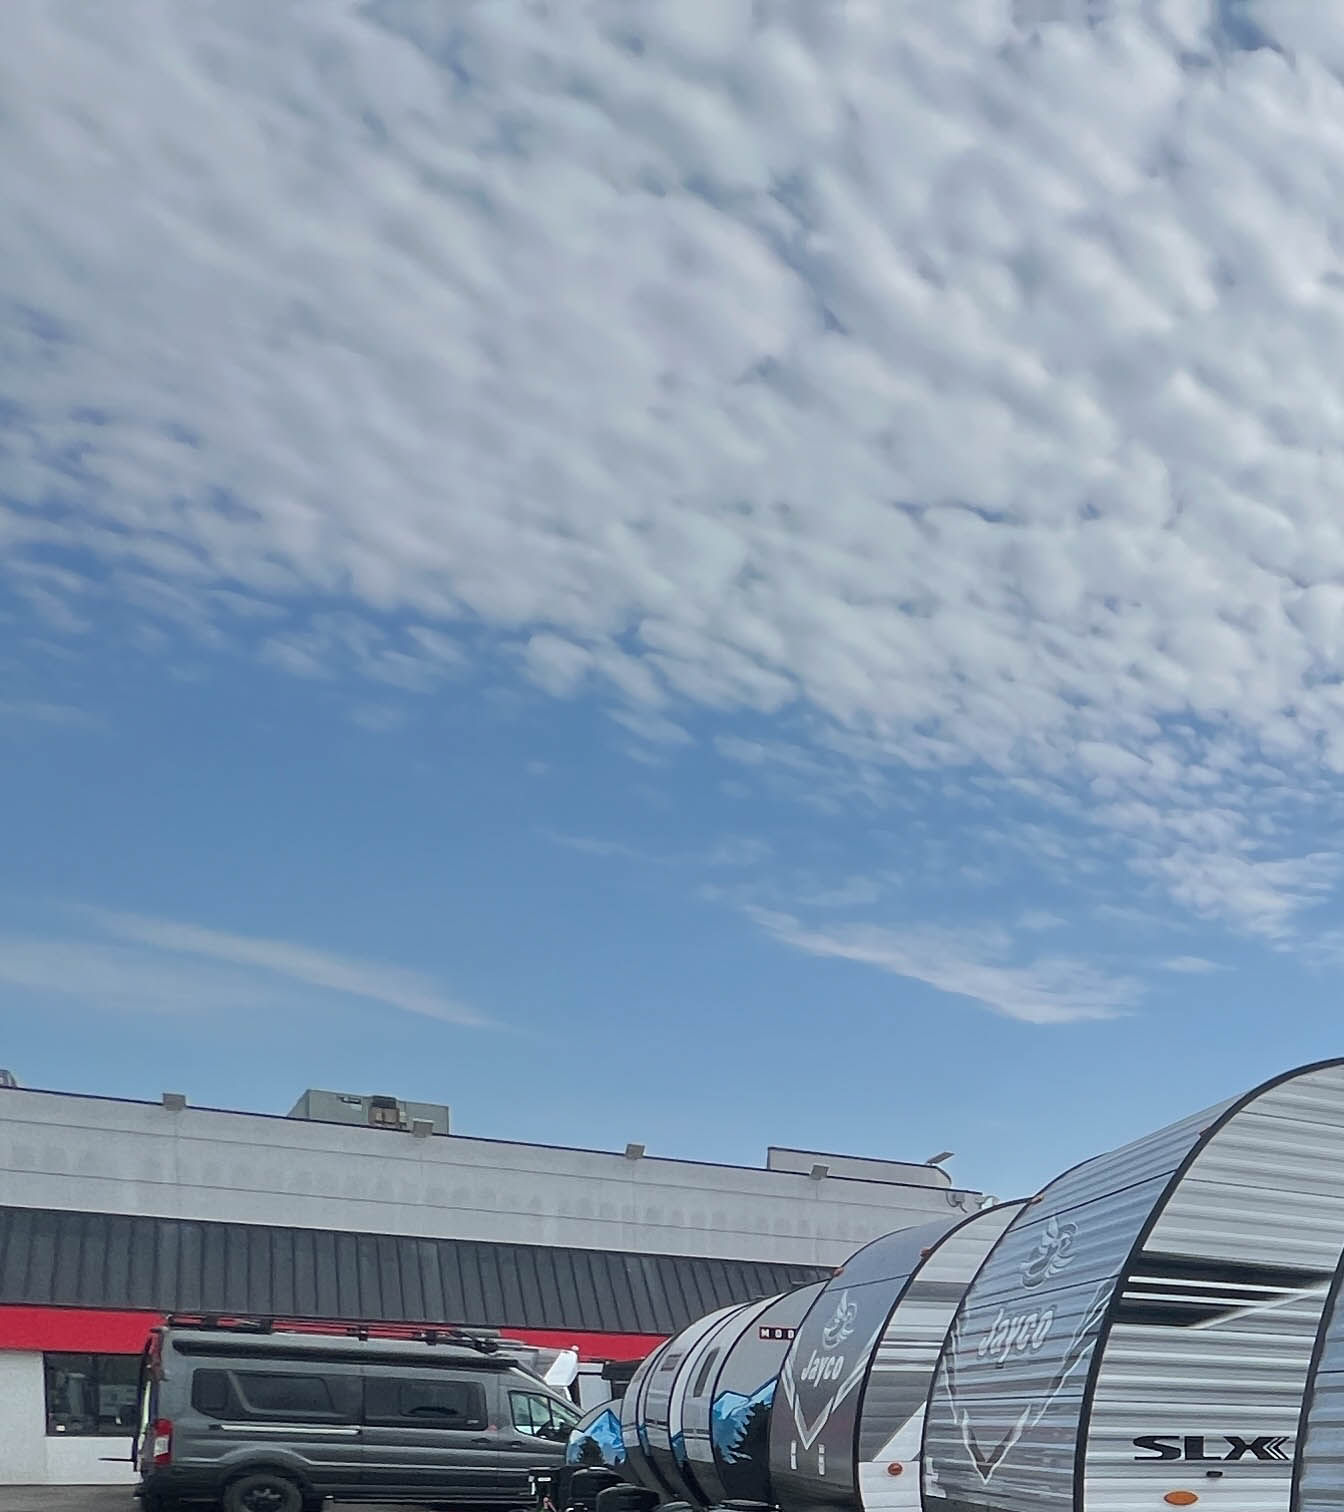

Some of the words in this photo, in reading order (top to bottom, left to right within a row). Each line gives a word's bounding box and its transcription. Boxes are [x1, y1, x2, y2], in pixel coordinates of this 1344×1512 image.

[977, 1304, 1057, 1364] Jayco
[800, 1349, 845, 1388] Jayco
[1133, 1435, 1290, 1461] SLX
